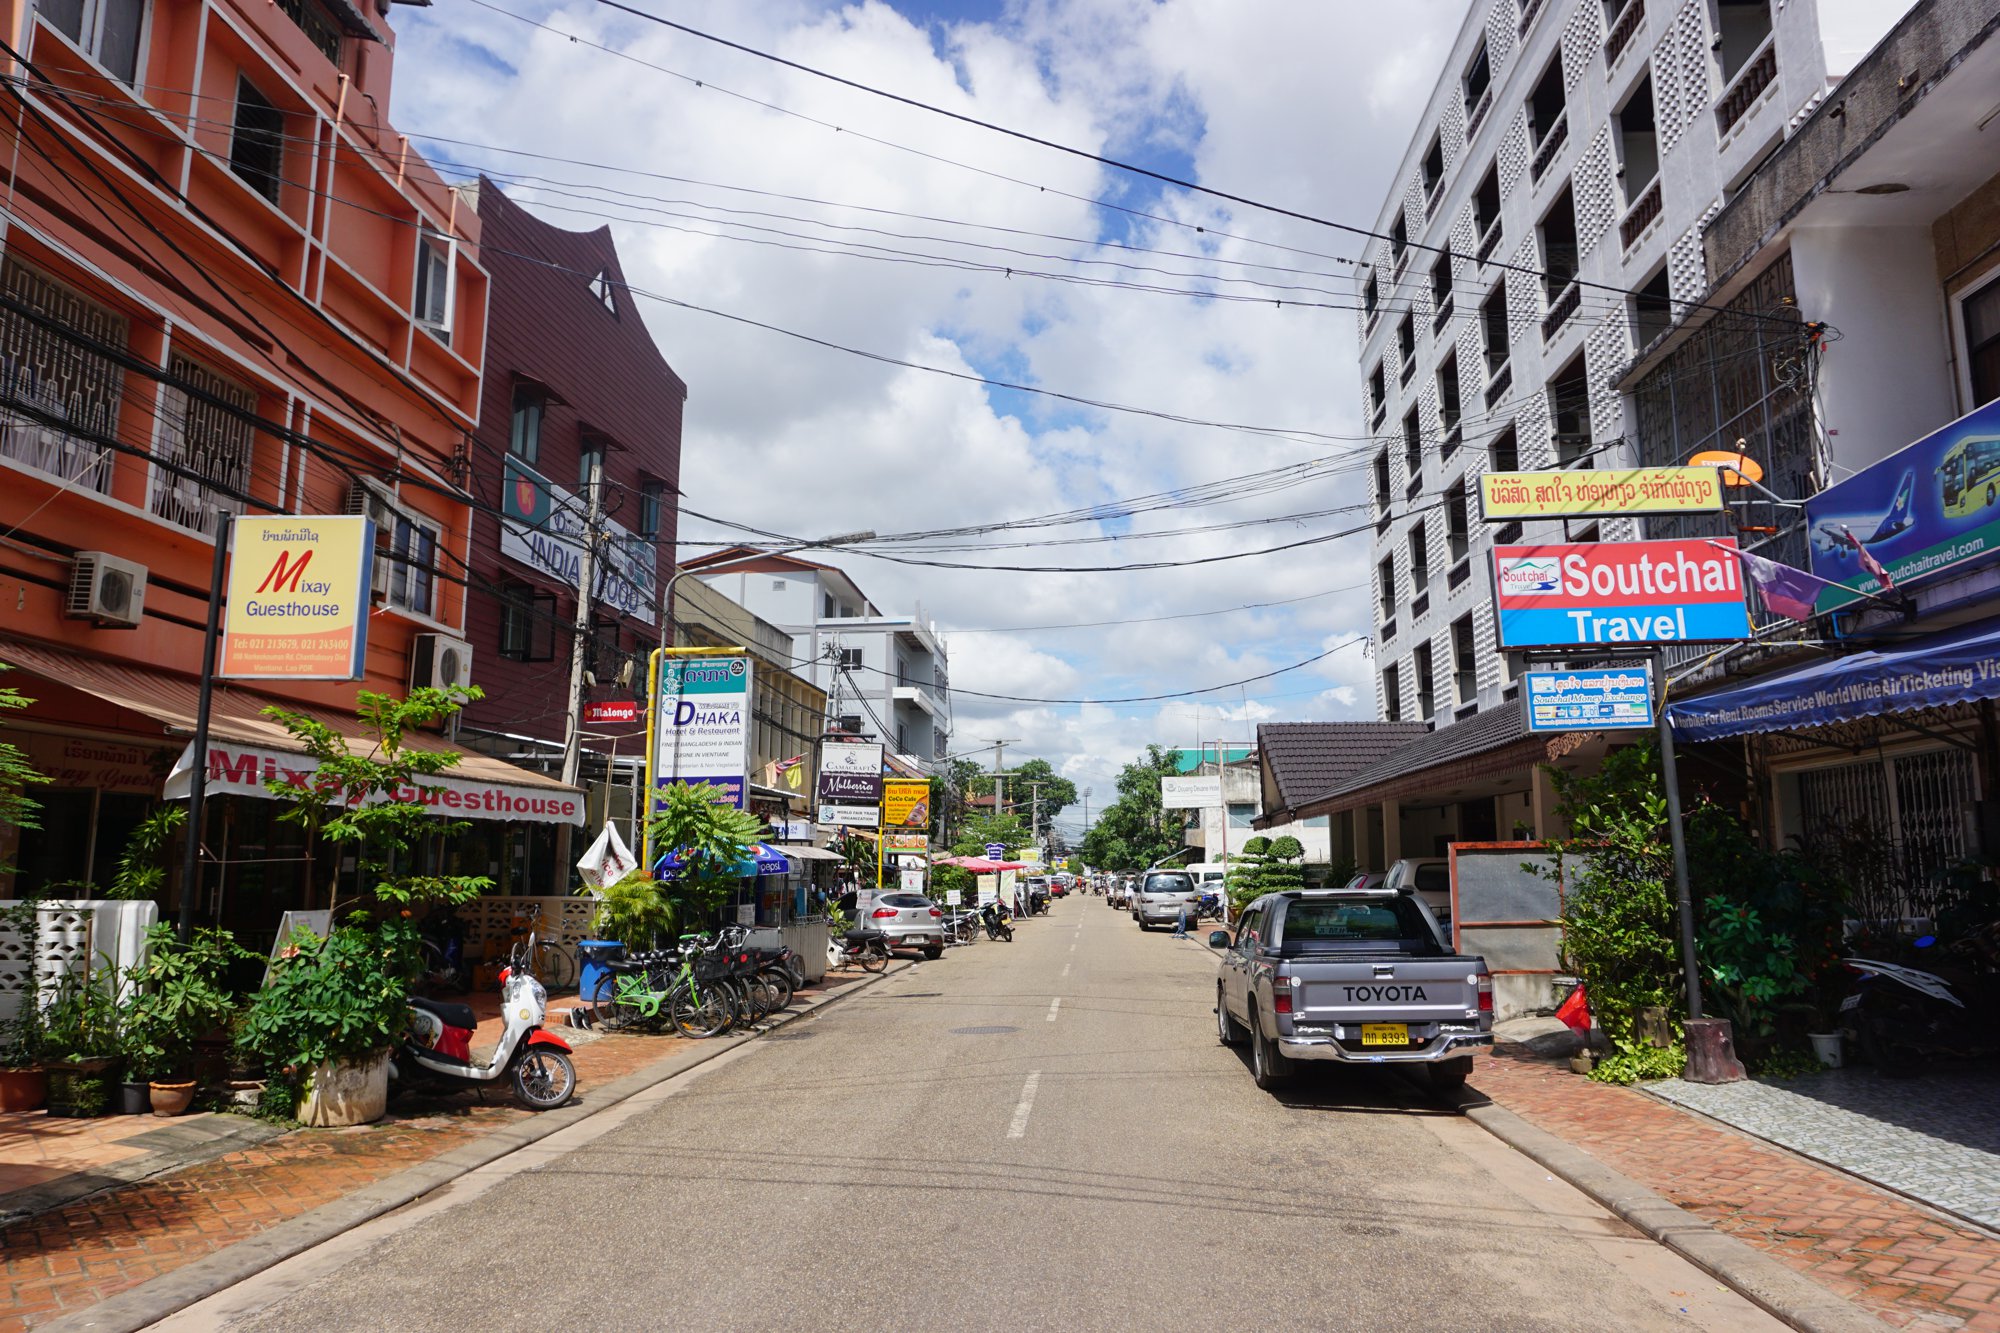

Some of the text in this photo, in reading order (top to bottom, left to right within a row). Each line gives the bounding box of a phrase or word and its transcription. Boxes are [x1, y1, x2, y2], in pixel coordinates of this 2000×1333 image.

[1490, 477, 1531, 505] ບໍລິສັດ
[1535, 476, 1572, 510] ສຸດໃຈ
[255, 549, 331, 596] Mixay
[1563, 551, 1737, 596] Soutchai
[1858, 537, 1985, 592] wwwoutchaitravel.com
[246, 600, 339, 617] Guesthouse
[1567, 608, 1687, 642] Travel
[234, 638, 249, 649] Tel:
[249, 638, 265, 649] 021
[301, 639, 316, 649] 021
[1533, 692, 1646, 704] Soutchai Money Exchange
[1719, 707, 1741, 722] Rent
[1741, 704, 1774, 721] Rooms
[1774, 696, 1815, 715] Service
[1815, 687, 1849, 707] World
[1848, 683, 1881, 702] Wide
[1881, 677, 1901, 697] Air
[1900, 666, 1973, 688] Ticketing
[593, 708, 634, 719] Malongo
[673, 701, 740, 726] DHAKA
[665, 728, 687, 736] Hotel
[697, 728, 741, 736] Restaurant
[822, 776, 873, 795] Mulberries
[388, 777, 575, 816] Guesthouse
[760, 861, 781, 873] pepsi
[1343, 986, 1428, 1001] TOYOTA
[1382, 1032, 1406, 1043] 8393
